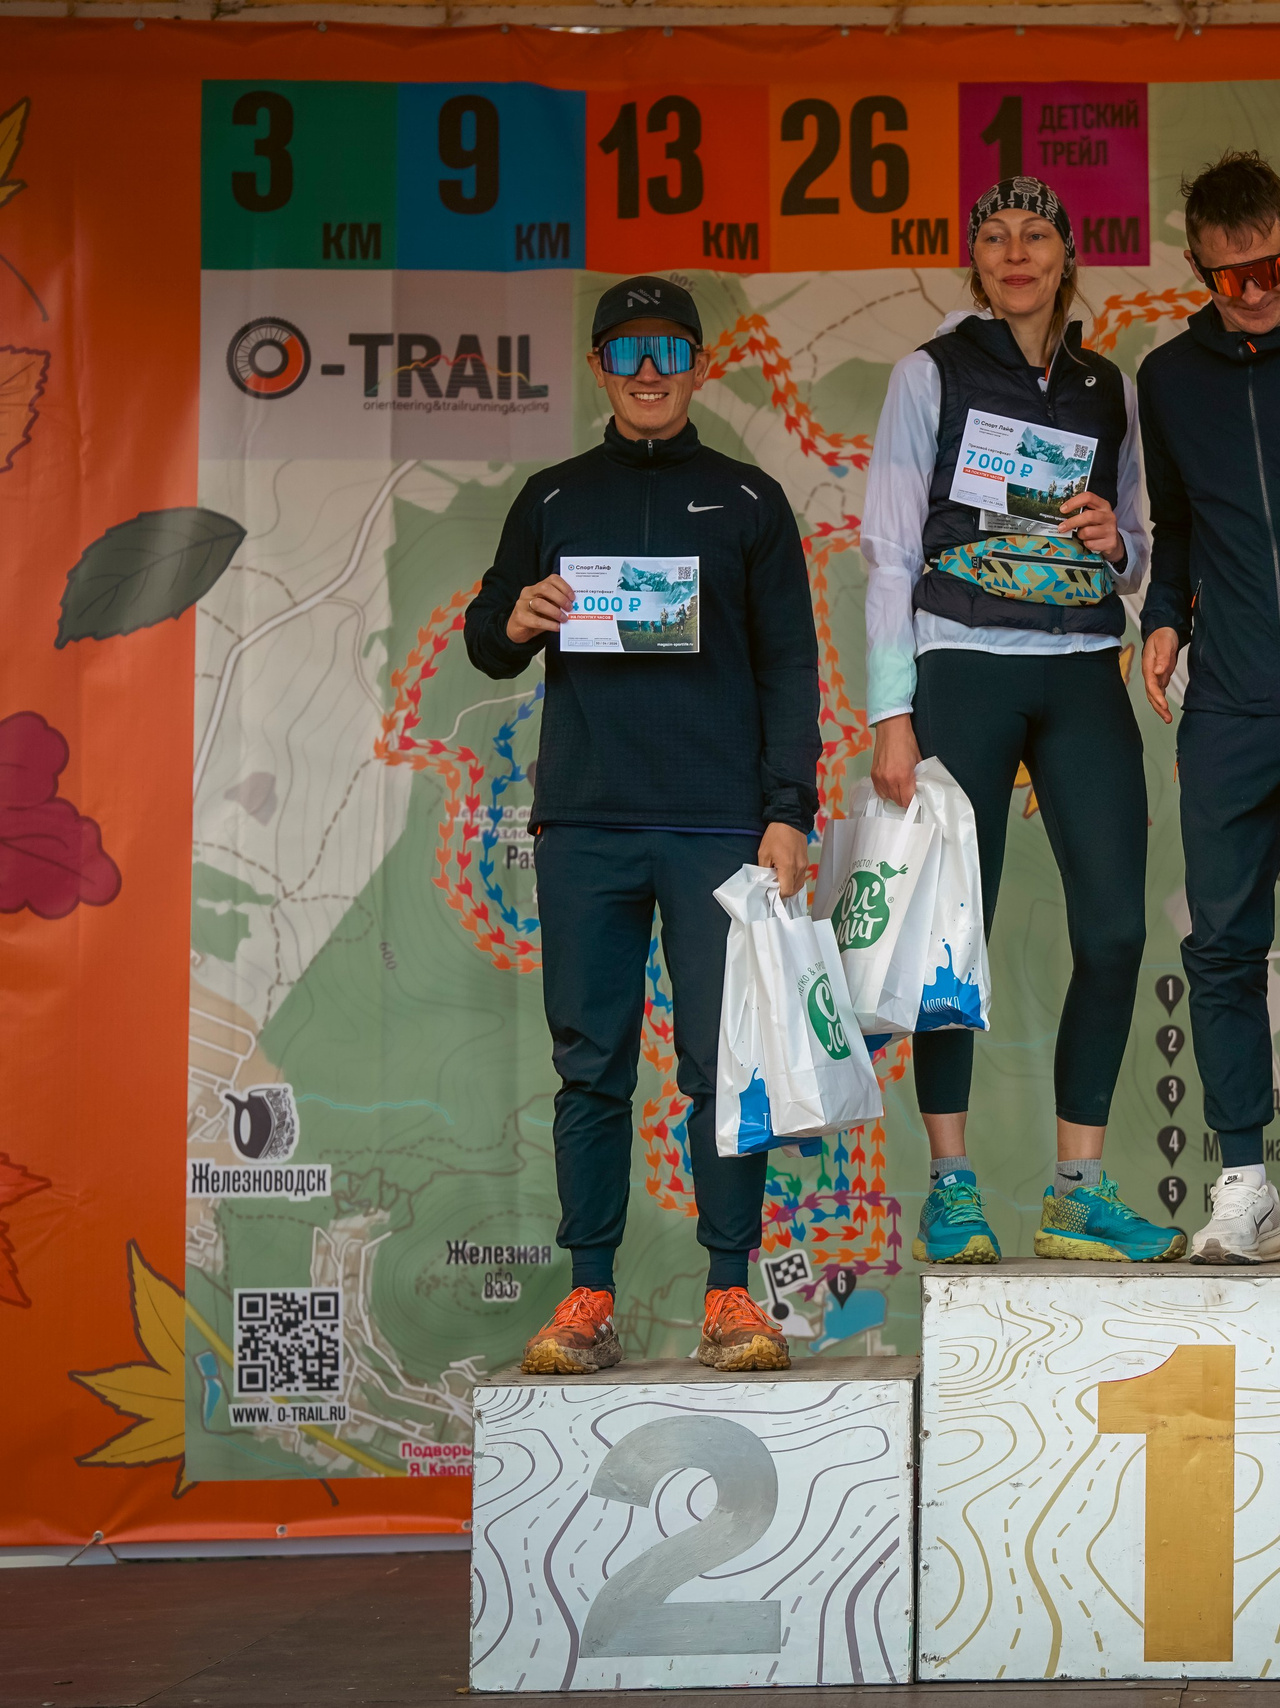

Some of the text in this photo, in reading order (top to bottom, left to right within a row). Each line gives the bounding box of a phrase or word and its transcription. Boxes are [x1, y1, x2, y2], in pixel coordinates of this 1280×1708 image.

[1038, 99, 1139, 134] ДЕТСКИЙ
[231, 90, 294, 213] 3
[980, 95, 1023, 179] 1
[1040, 136, 1109, 167] ТРЕЙЛ
[438, 95, 500, 215] 9
[598, 95, 704, 219] 13
[780, 95, 910, 216] 26
[322, 222, 382, 260] КМ
[515, 222, 571, 261] КМ
[703, 220, 759, 261] КМ
[891, 218, 949, 256] КМ
[1082, 216, 1140, 254] КМ
[981, 420, 998, 430] Спорт
[998, 424, 1014, 433] Лайф
[594, 563, 611, 571] Лайф
[1167, 978, 1174, 1001] 1
[1168, 1028, 1177, 1052] 2
[1168, 1079, 1177, 1103] 3
[1169, 1130, 1179, 1153] 4
[191, 1164, 327, 1197] Железноводск
[1168, 1179, 1177, 1203] 5
[446, 1239, 552, 1265] Железная
[837, 1273, 846, 1292] 6
[277, 1404, 347, 1423] O-TRAIL.RU
[1098, 1344, 1236, 1663] 1
[578, 1414, 781, 1660] 2
